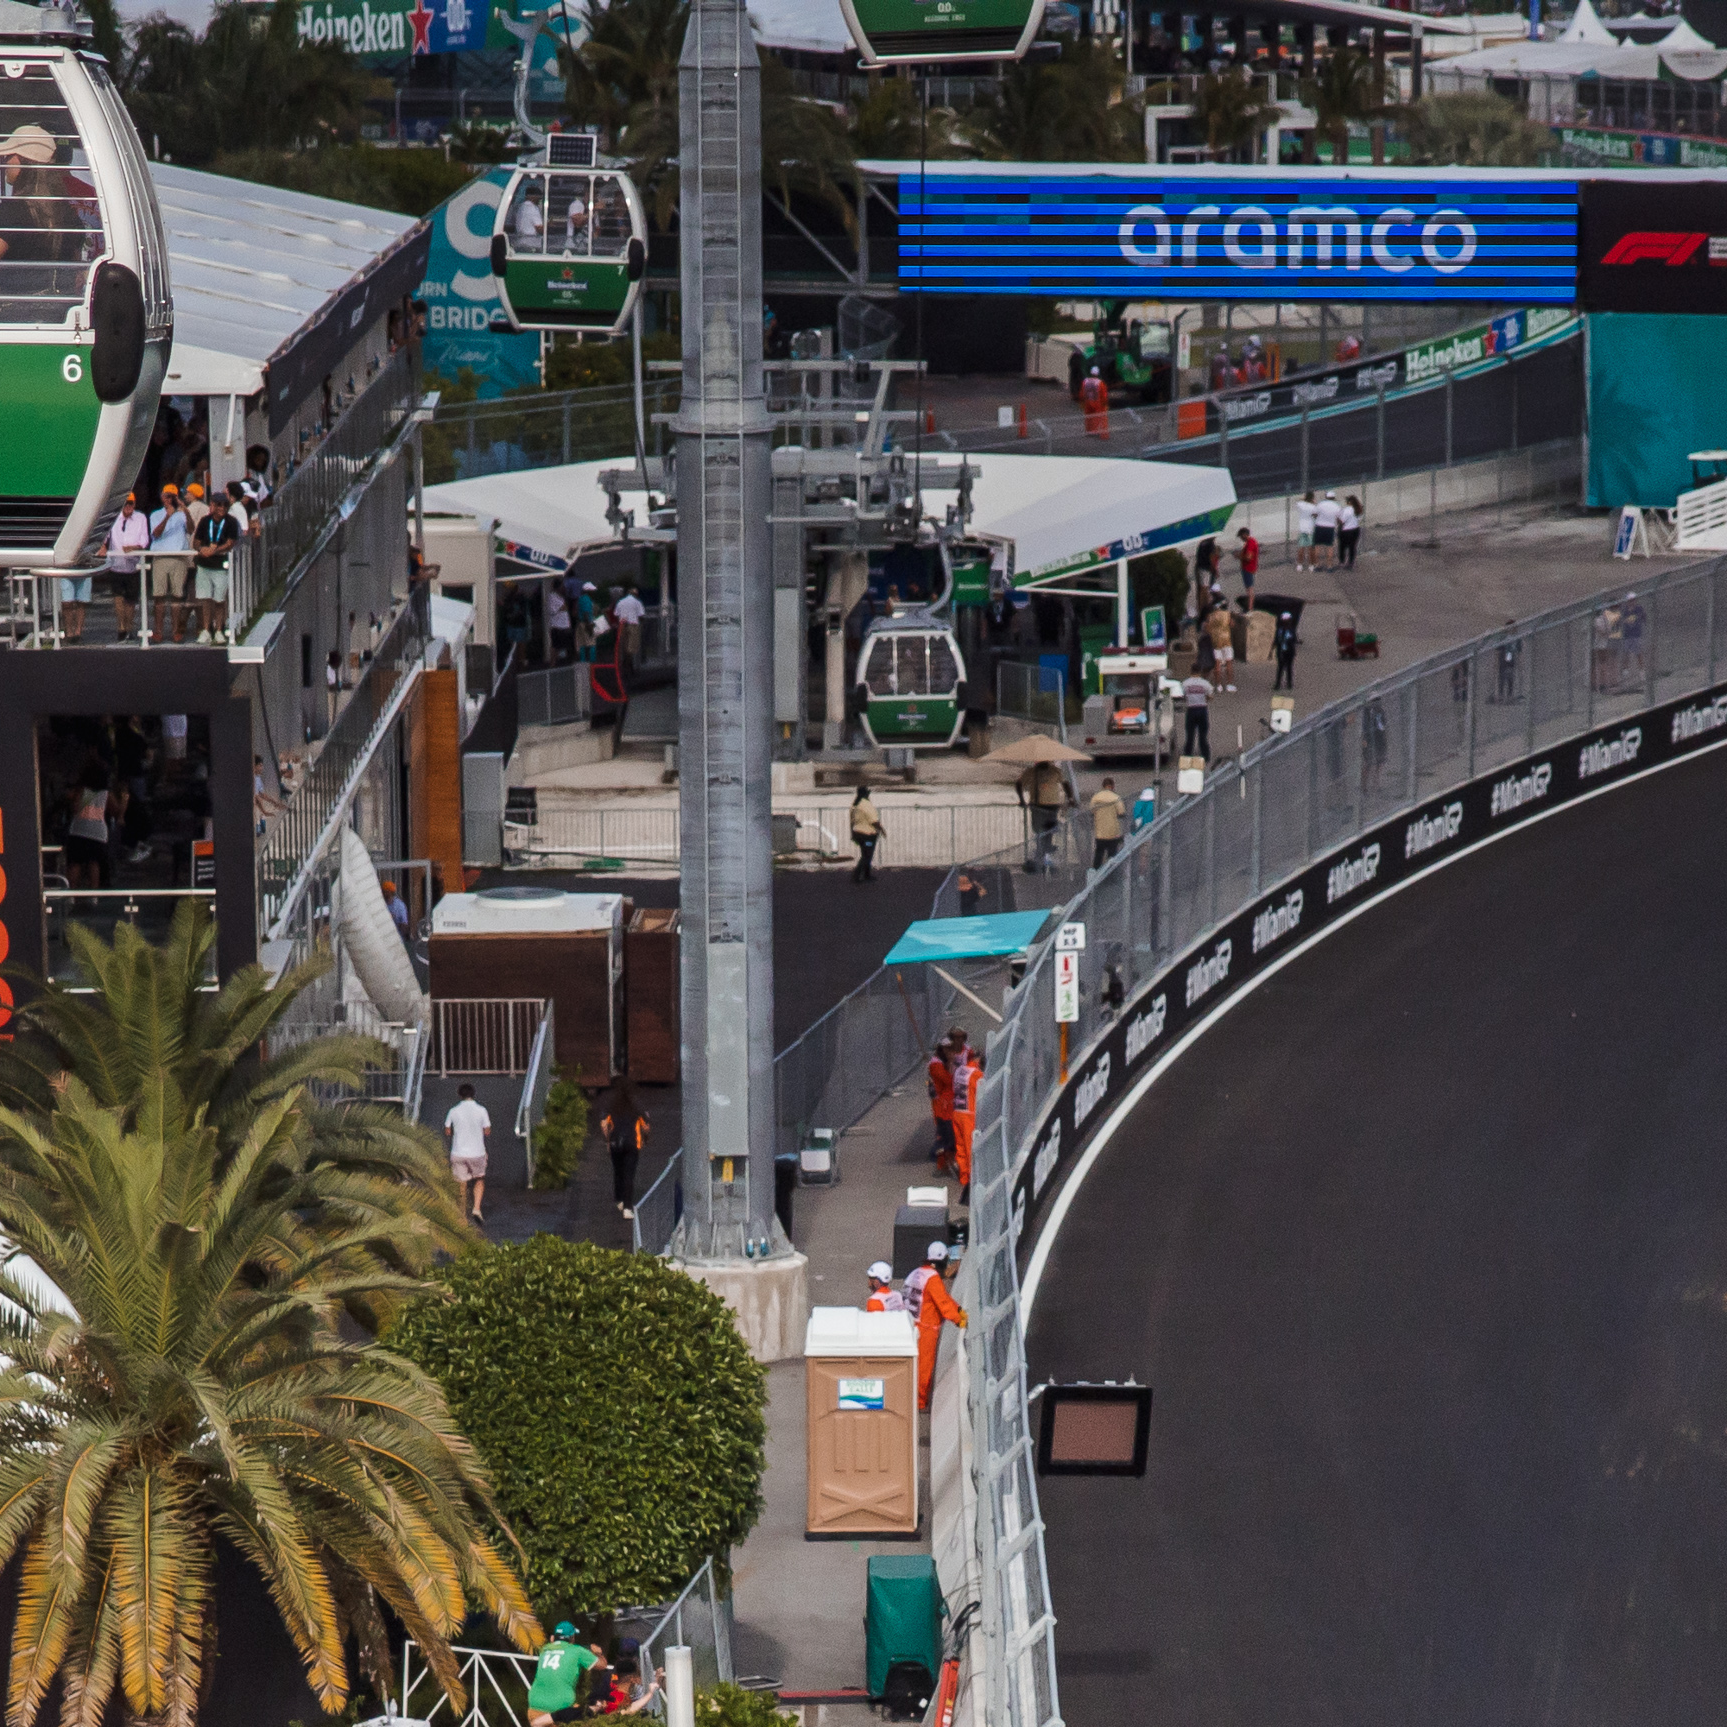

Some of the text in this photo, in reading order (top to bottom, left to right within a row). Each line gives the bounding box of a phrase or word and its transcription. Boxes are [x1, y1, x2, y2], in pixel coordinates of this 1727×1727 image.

[1118, 205, 1478, 274] aramco
[430, 306, 511, 330] BRIDG
[62, 354, 83, 382] 6
[542, 1653, 561, 1671] 14
